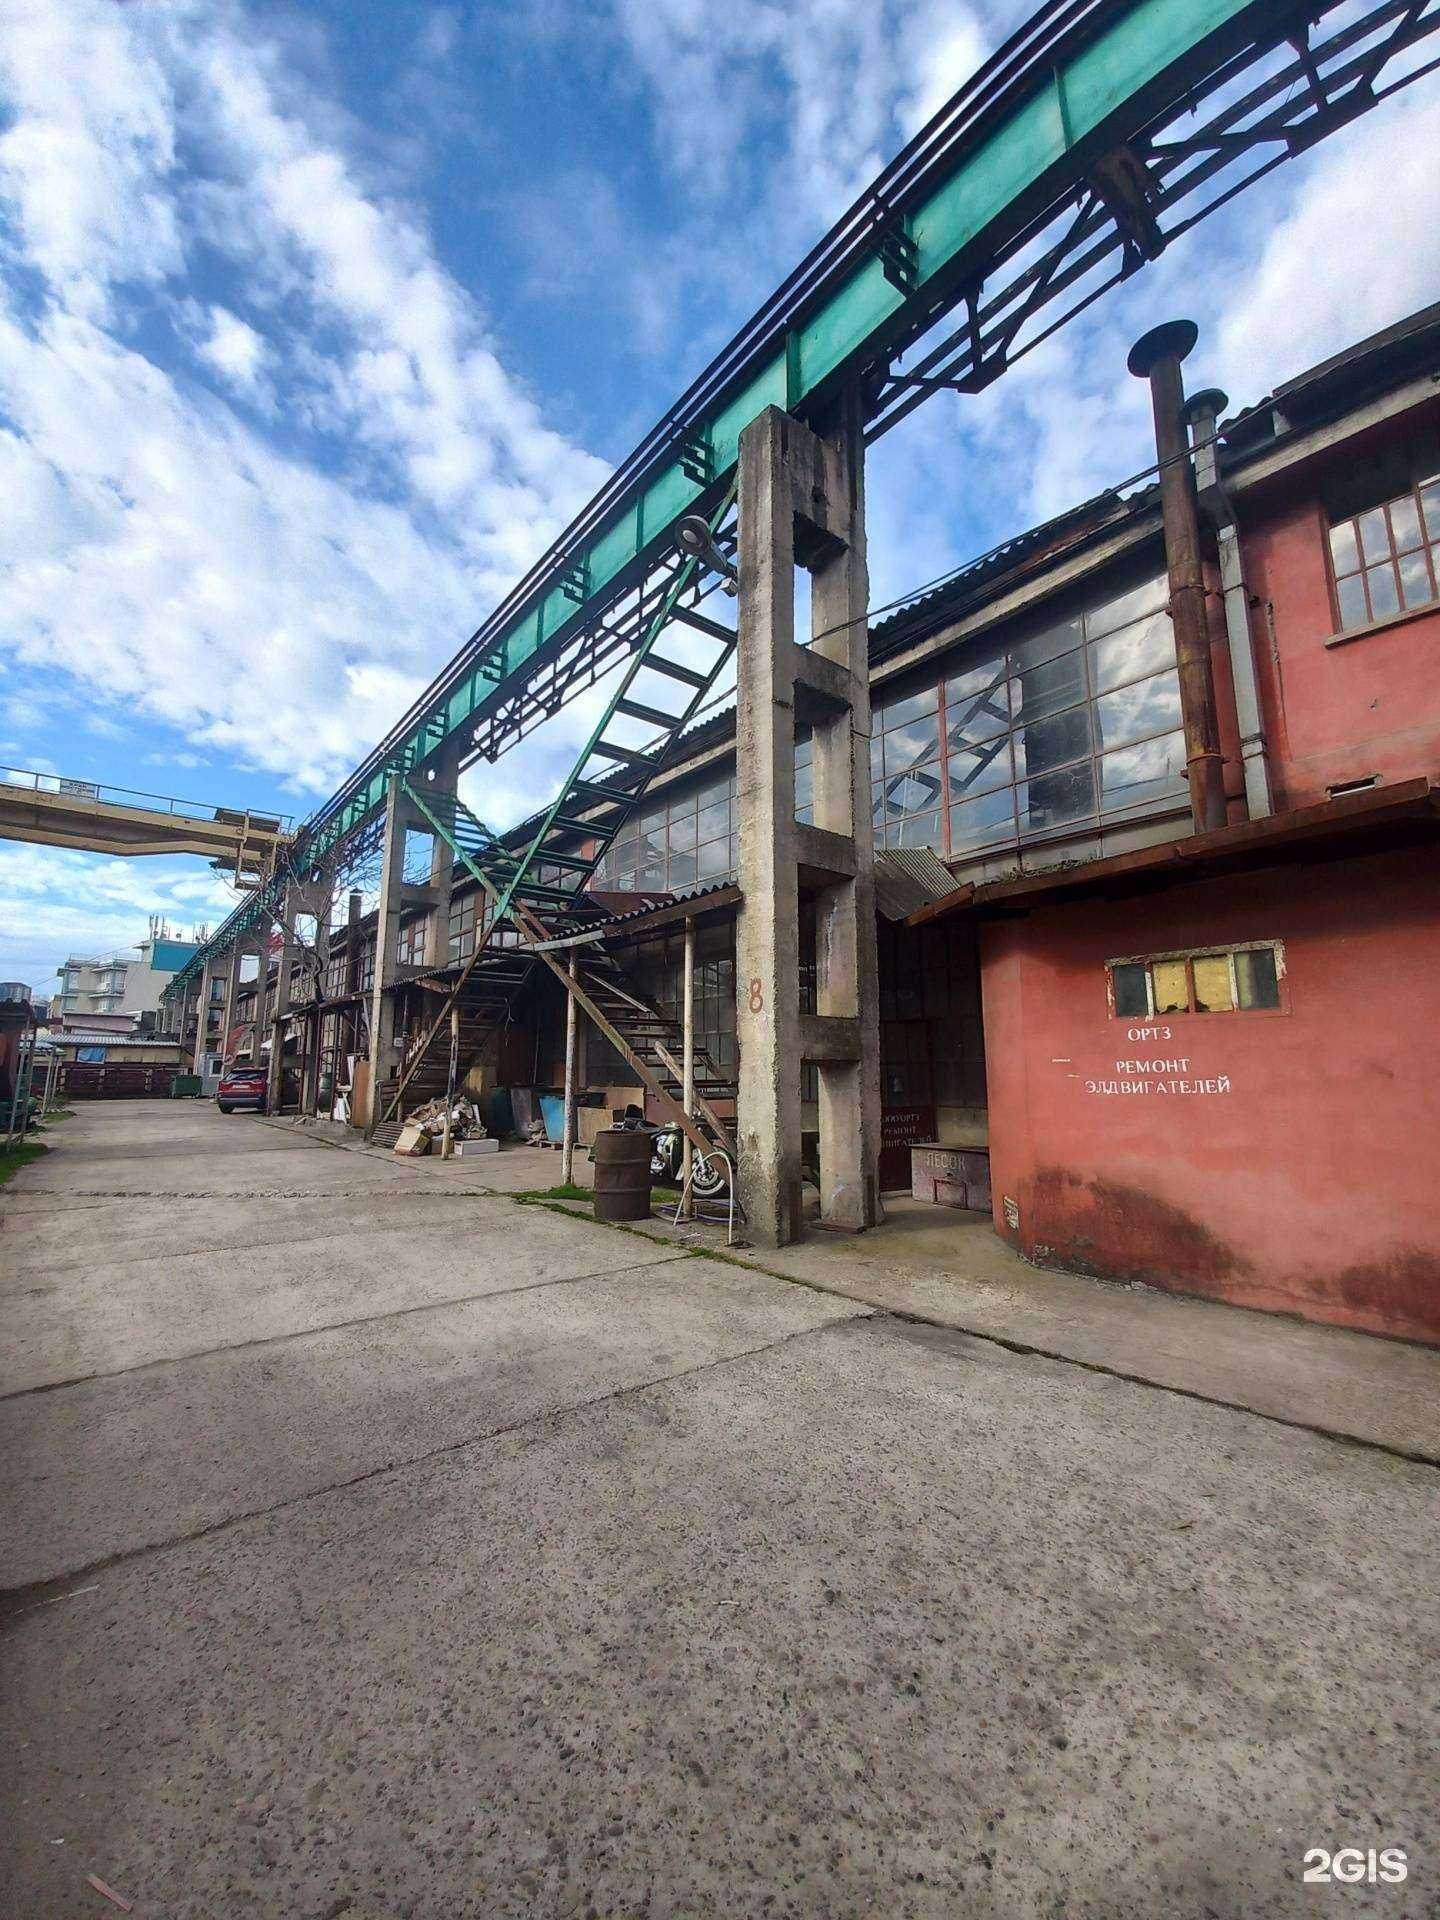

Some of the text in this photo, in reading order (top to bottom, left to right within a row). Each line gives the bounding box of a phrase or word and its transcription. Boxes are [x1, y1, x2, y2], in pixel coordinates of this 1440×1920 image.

[749, 977, 763, 1013] 8
[1128, 1026, 1171, 1041] ОРТЗ
[1116, 1058, 1190, 1074] РЕМОНТ
[1085, 1075, 1231, 1094] ЭЛДВИГАТЕЛЕЙ
